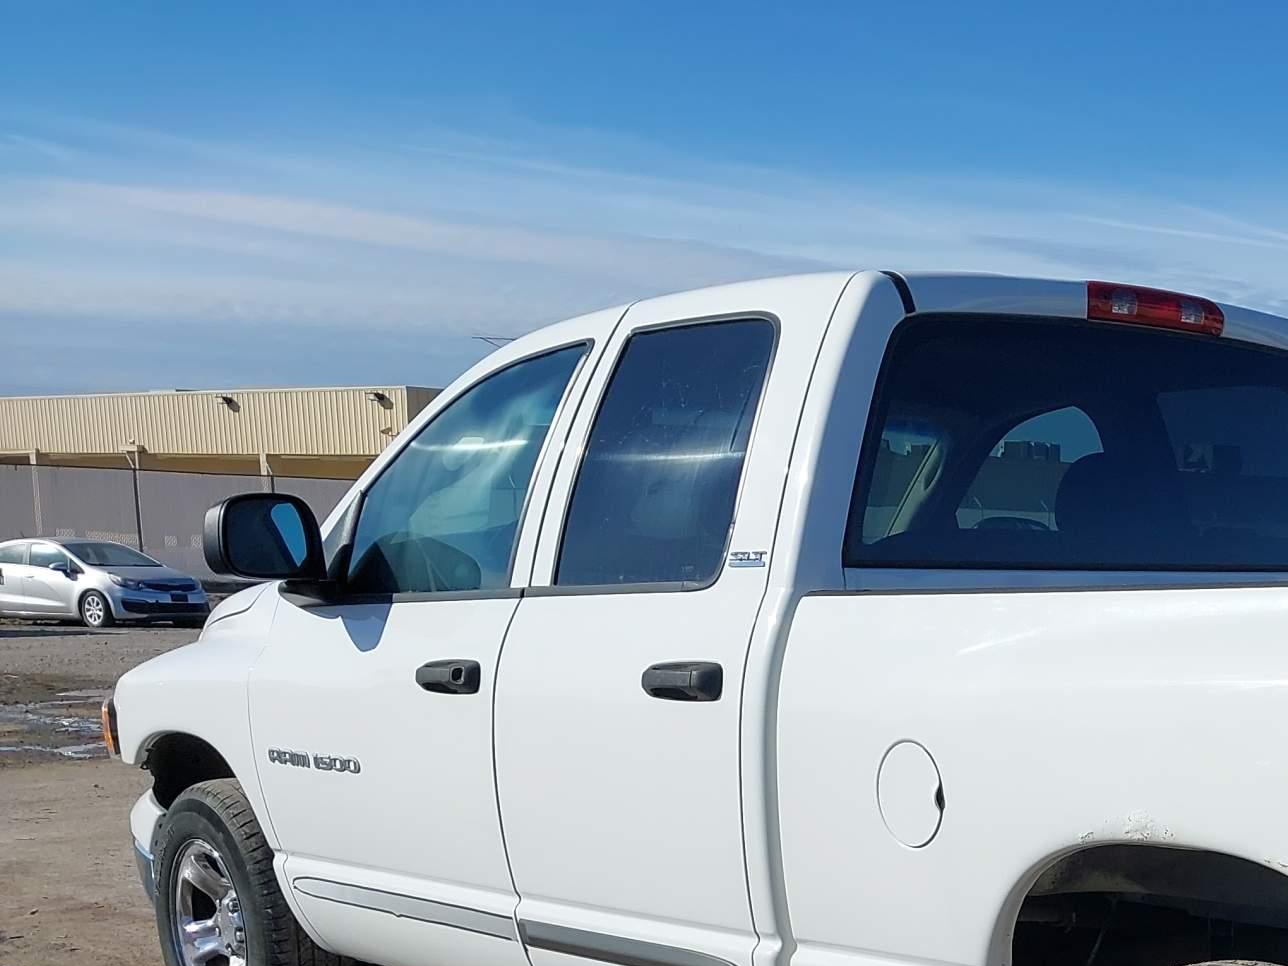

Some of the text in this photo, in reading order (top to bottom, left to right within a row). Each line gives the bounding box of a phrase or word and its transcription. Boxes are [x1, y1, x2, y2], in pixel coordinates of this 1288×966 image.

[730, 551, 768, 561] SLT
[268, 749, 361, 774] RAM 1500
